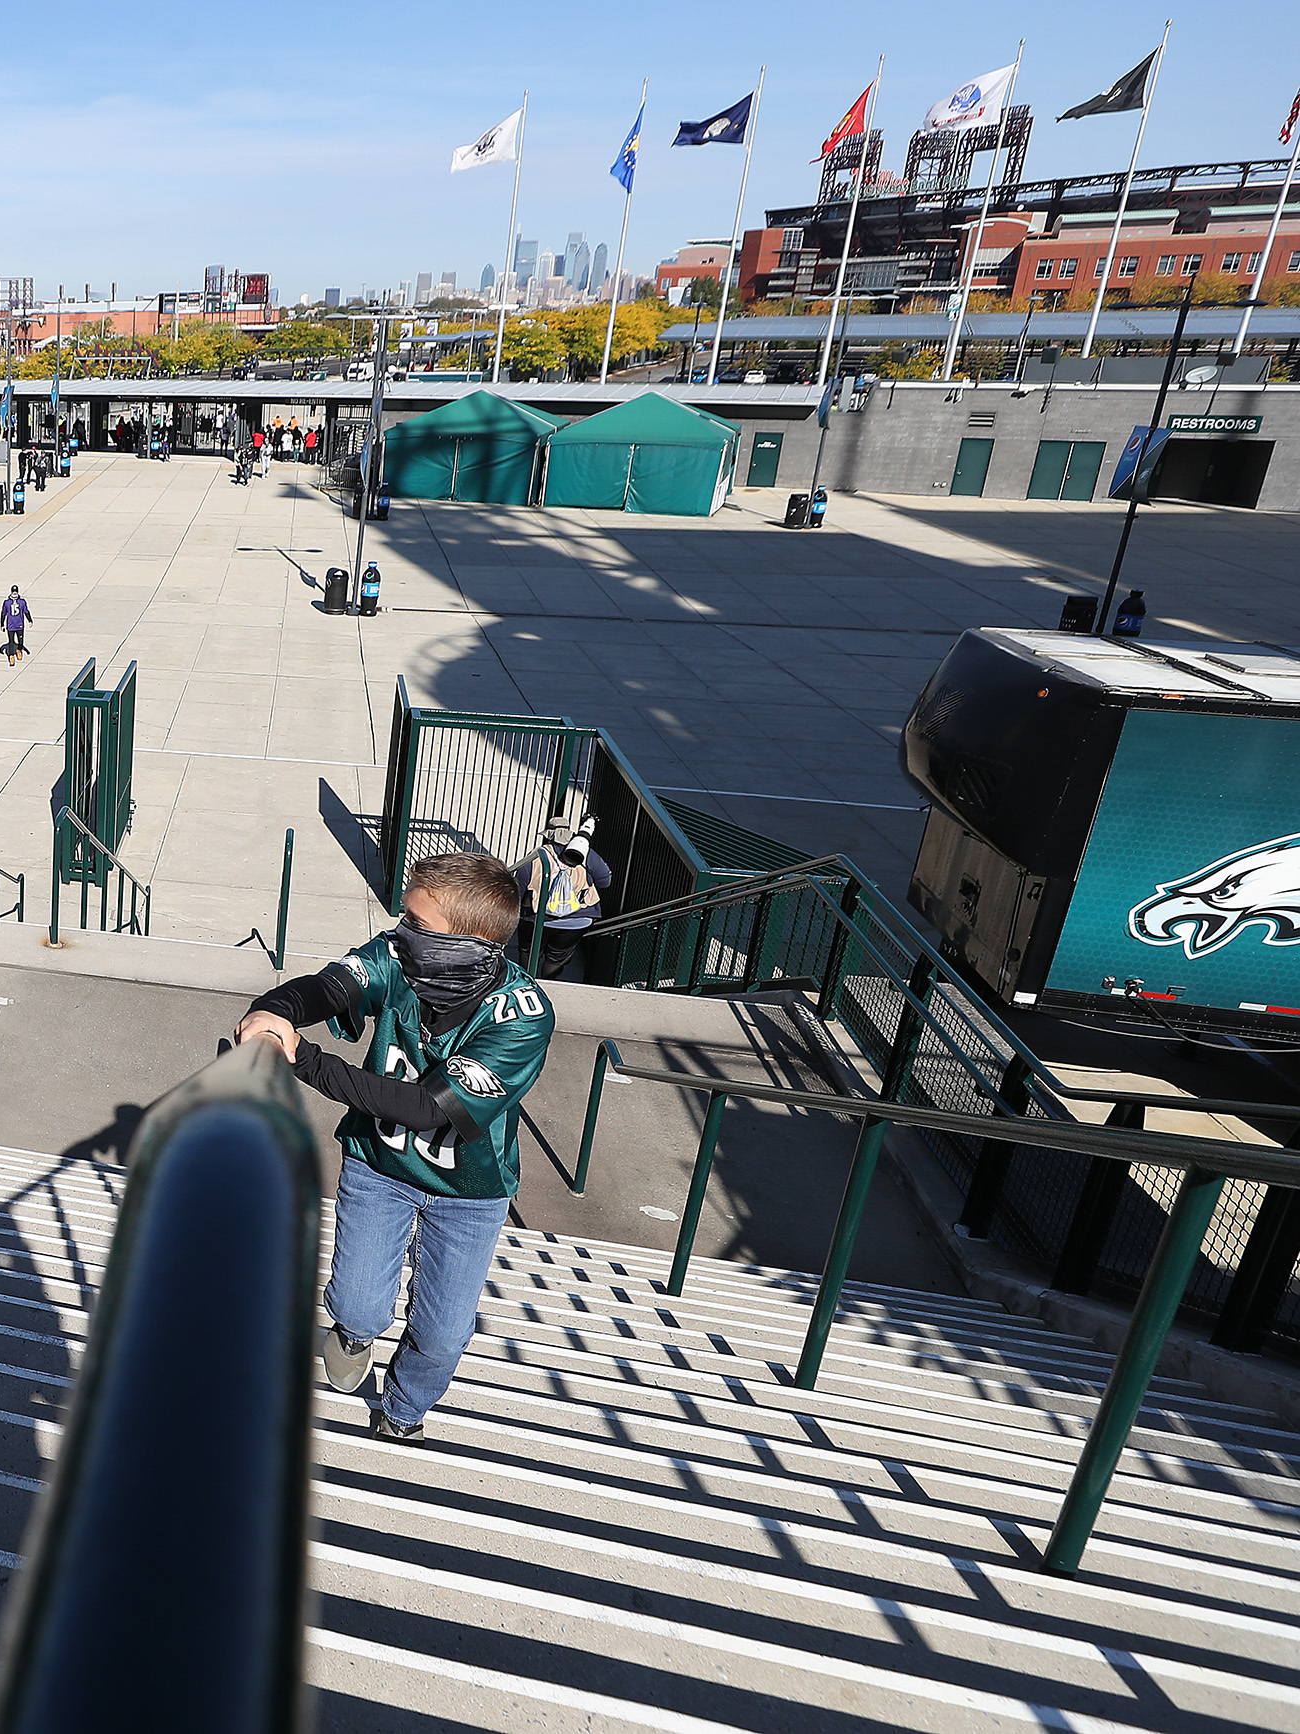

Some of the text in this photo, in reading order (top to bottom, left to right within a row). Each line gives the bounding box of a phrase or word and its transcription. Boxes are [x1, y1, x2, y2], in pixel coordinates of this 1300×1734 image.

[1170, 417, 1257, 430] RESTROOMS
[10, 606, 20, 617] 15
[483, 985, 545, 1025] 26
